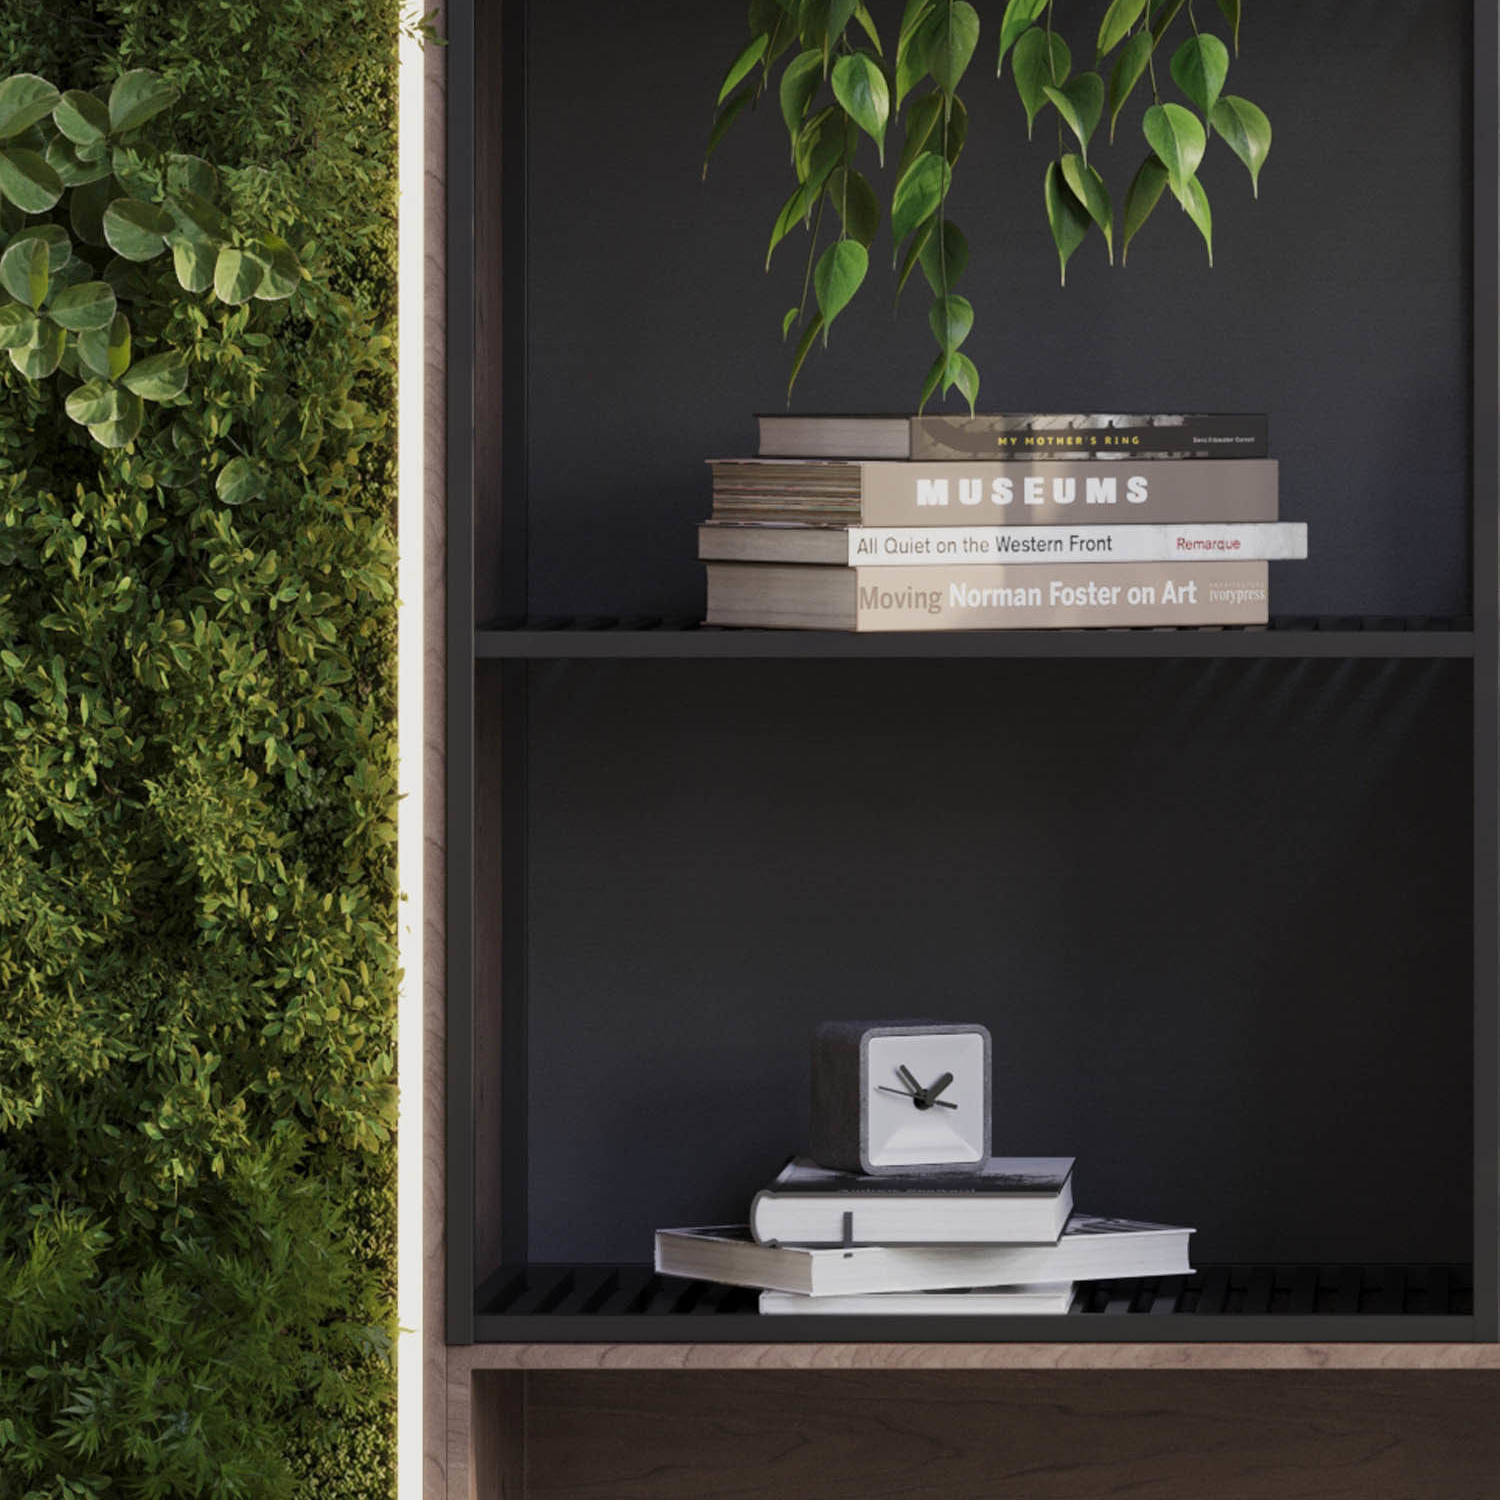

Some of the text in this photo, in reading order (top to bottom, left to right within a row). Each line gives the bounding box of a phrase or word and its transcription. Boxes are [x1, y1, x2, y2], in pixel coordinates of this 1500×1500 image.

[998, 436, 1141, 446] MY MOTHER'S RING
[916, 475, 1148, 506] MUSEUMS
[857, 534, 1113, 554] All Quiet on the Western Front
[1176, 537, 1242, 552] Remarque
[859, 579, 1198, 615] Moving Norman Foster on Art
[1209, 588, 1265, 604] ivorypress
